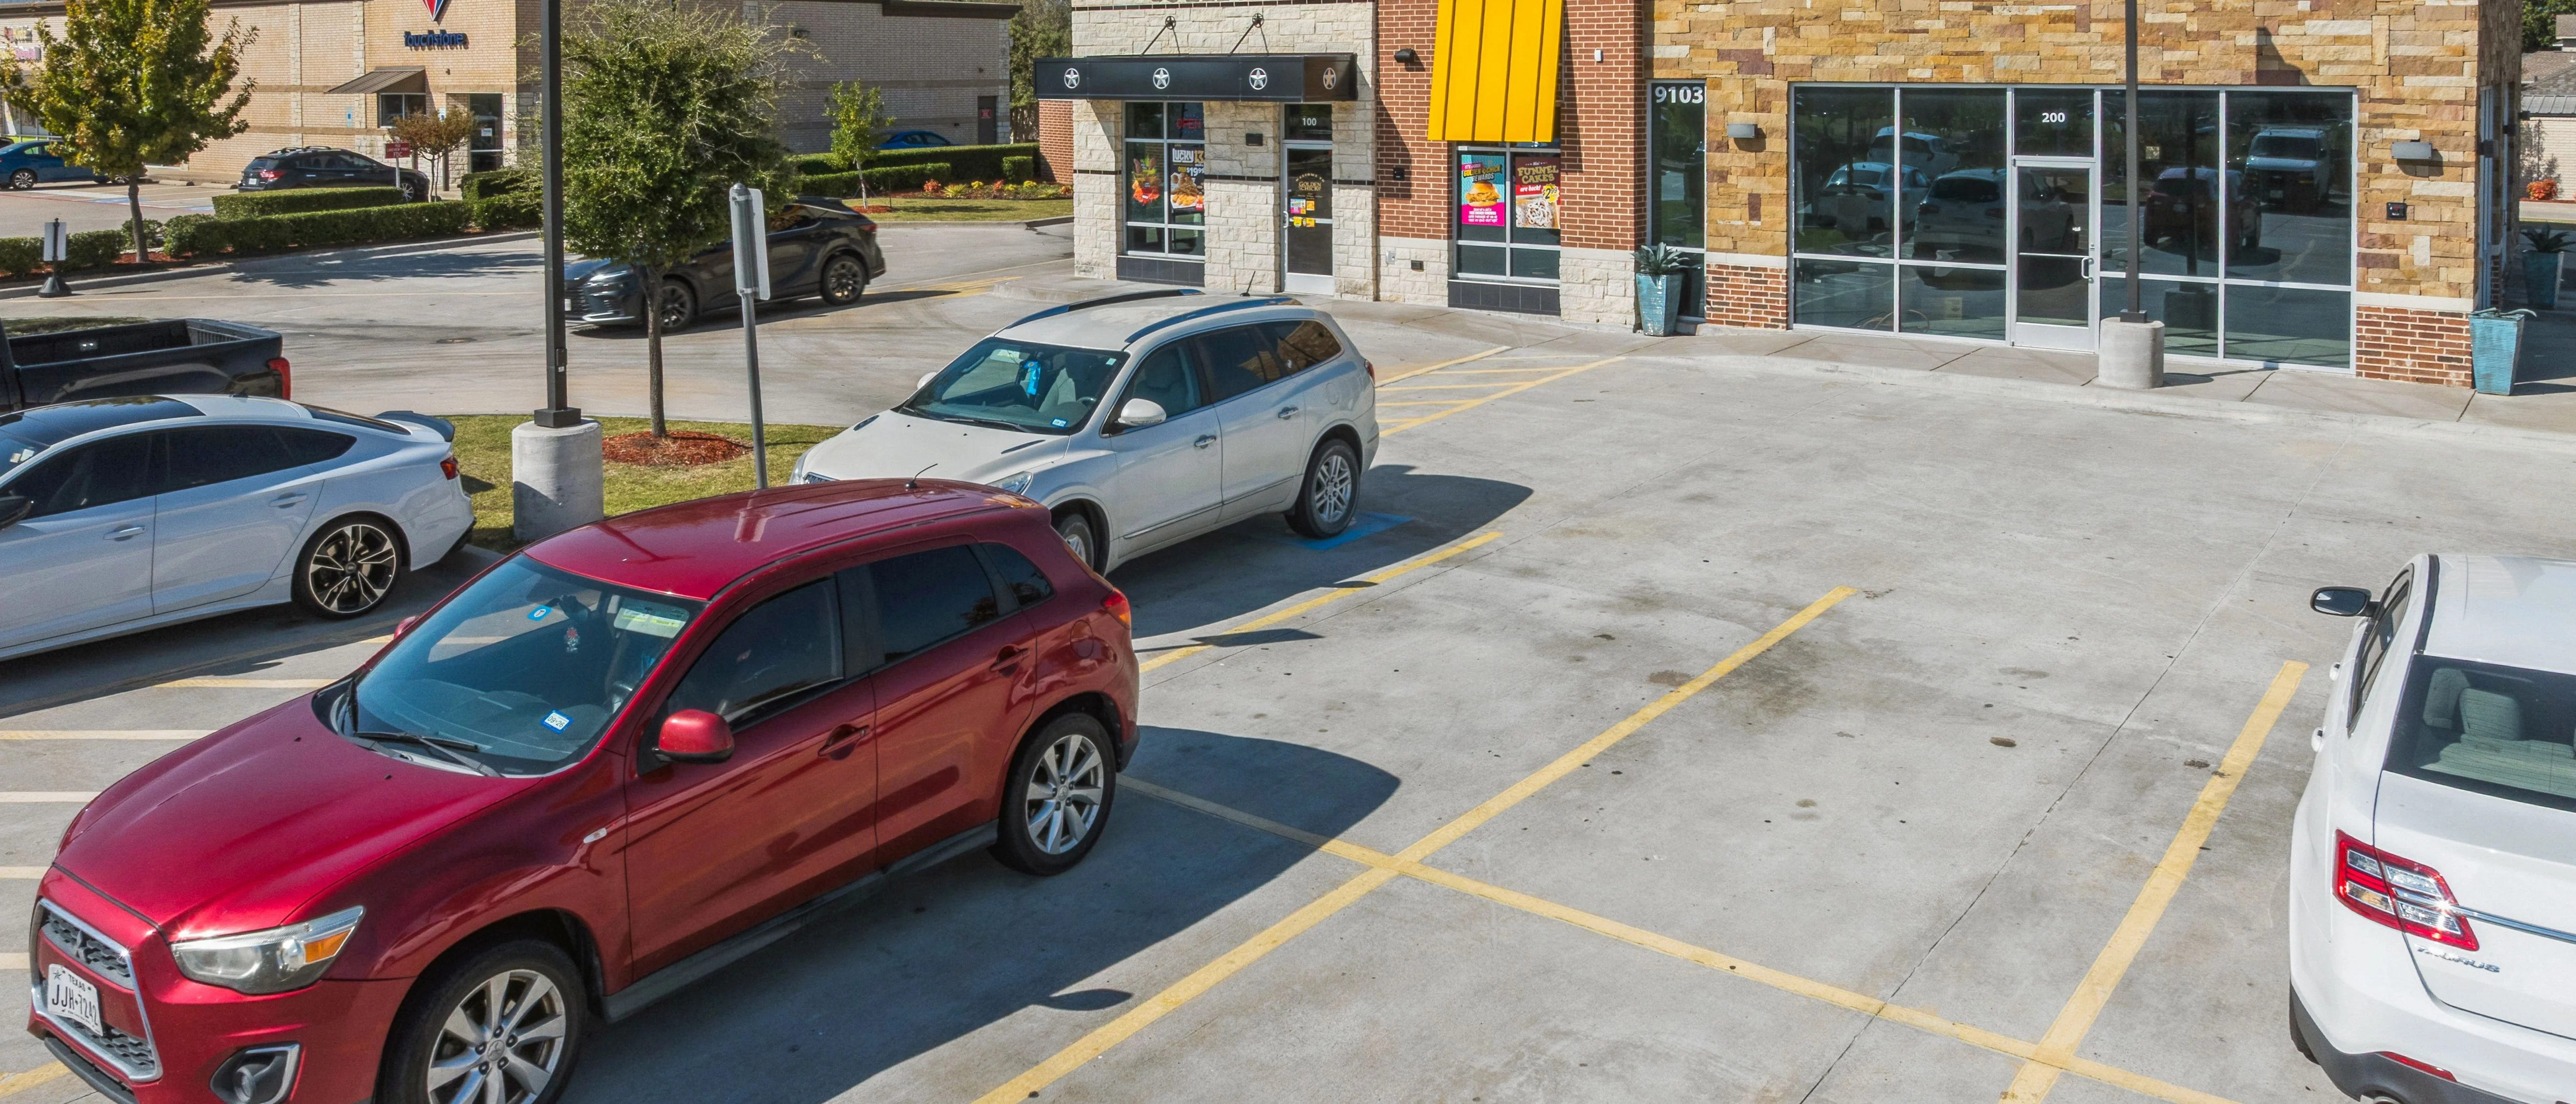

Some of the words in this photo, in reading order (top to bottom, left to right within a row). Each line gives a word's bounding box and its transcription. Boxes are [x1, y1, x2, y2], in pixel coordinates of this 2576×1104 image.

[1655, 86, 1703, 104] 9103
[1302, 117, 1317, 126] 100
[2042, 112, 2065, 123] 200
[1177, 118, 1201, 129] OPEN
[1172, 148, 1194, 163] LUCKY
[1194, 150, 1204, 164] 13
[1463, 168, 1481, 177] GOLDEN
[1486, 165, 1501, 173] CHICK
[1517, 165, 1559, 176] FUNNEL
[1472, 173, 1494, 182] REWARDS
[1522, 173, 1555, 184] CAKES
[68, 974, 86, 992] TEXAS
